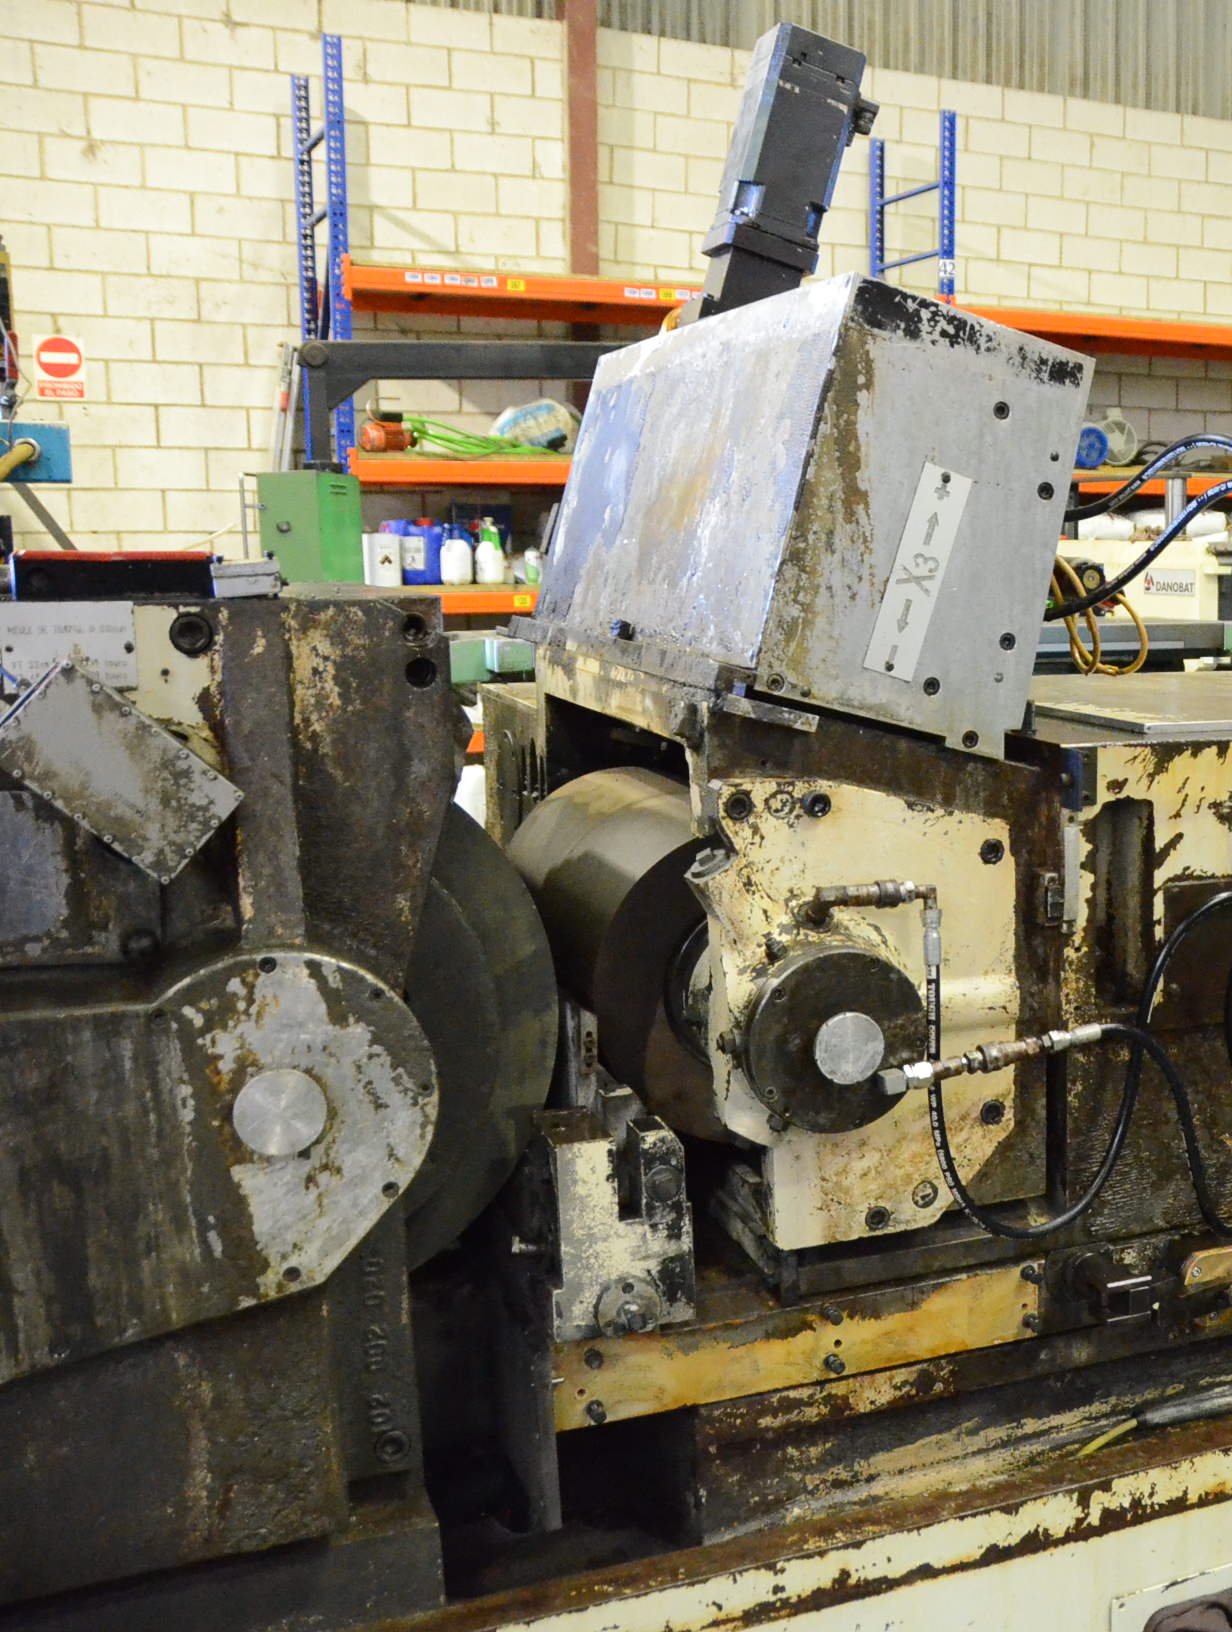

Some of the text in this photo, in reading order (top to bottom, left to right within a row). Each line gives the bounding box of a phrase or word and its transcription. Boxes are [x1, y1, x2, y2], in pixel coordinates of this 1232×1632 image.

[939, 261, 955, 275] 42
[895, 552, 940, 597] X3
[1156, 580, 1194, 593] DANOBAT
[930, 1093, 937, 1108] WP
